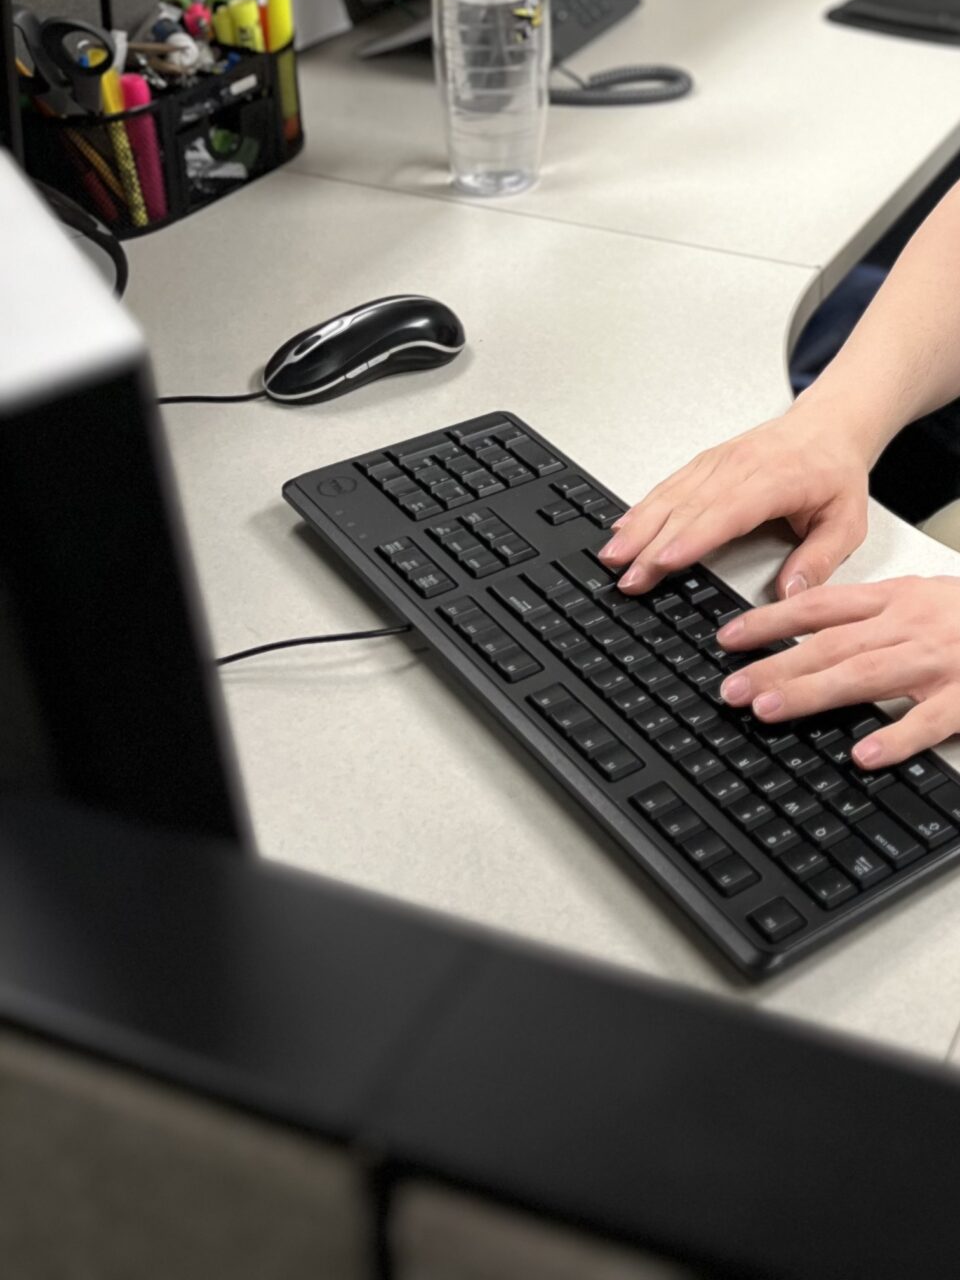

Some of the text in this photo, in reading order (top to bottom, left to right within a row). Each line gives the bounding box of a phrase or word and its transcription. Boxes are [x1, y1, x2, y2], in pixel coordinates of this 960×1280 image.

[689, 715, 700, 723] Y
[713, 736, 725, 746] T
[835, 751, 848, 761] X
[739, 758, 750, 768] R
[790, 758, 802, 767] D
[816, 780, 828, 790] S
[863, 776, 875, 784] Z
[763, 781, 775, 790] E
[785, 801, 800, 813] W
[842, 803, 854, 812] A
[815, 827, 827, 838] Q
